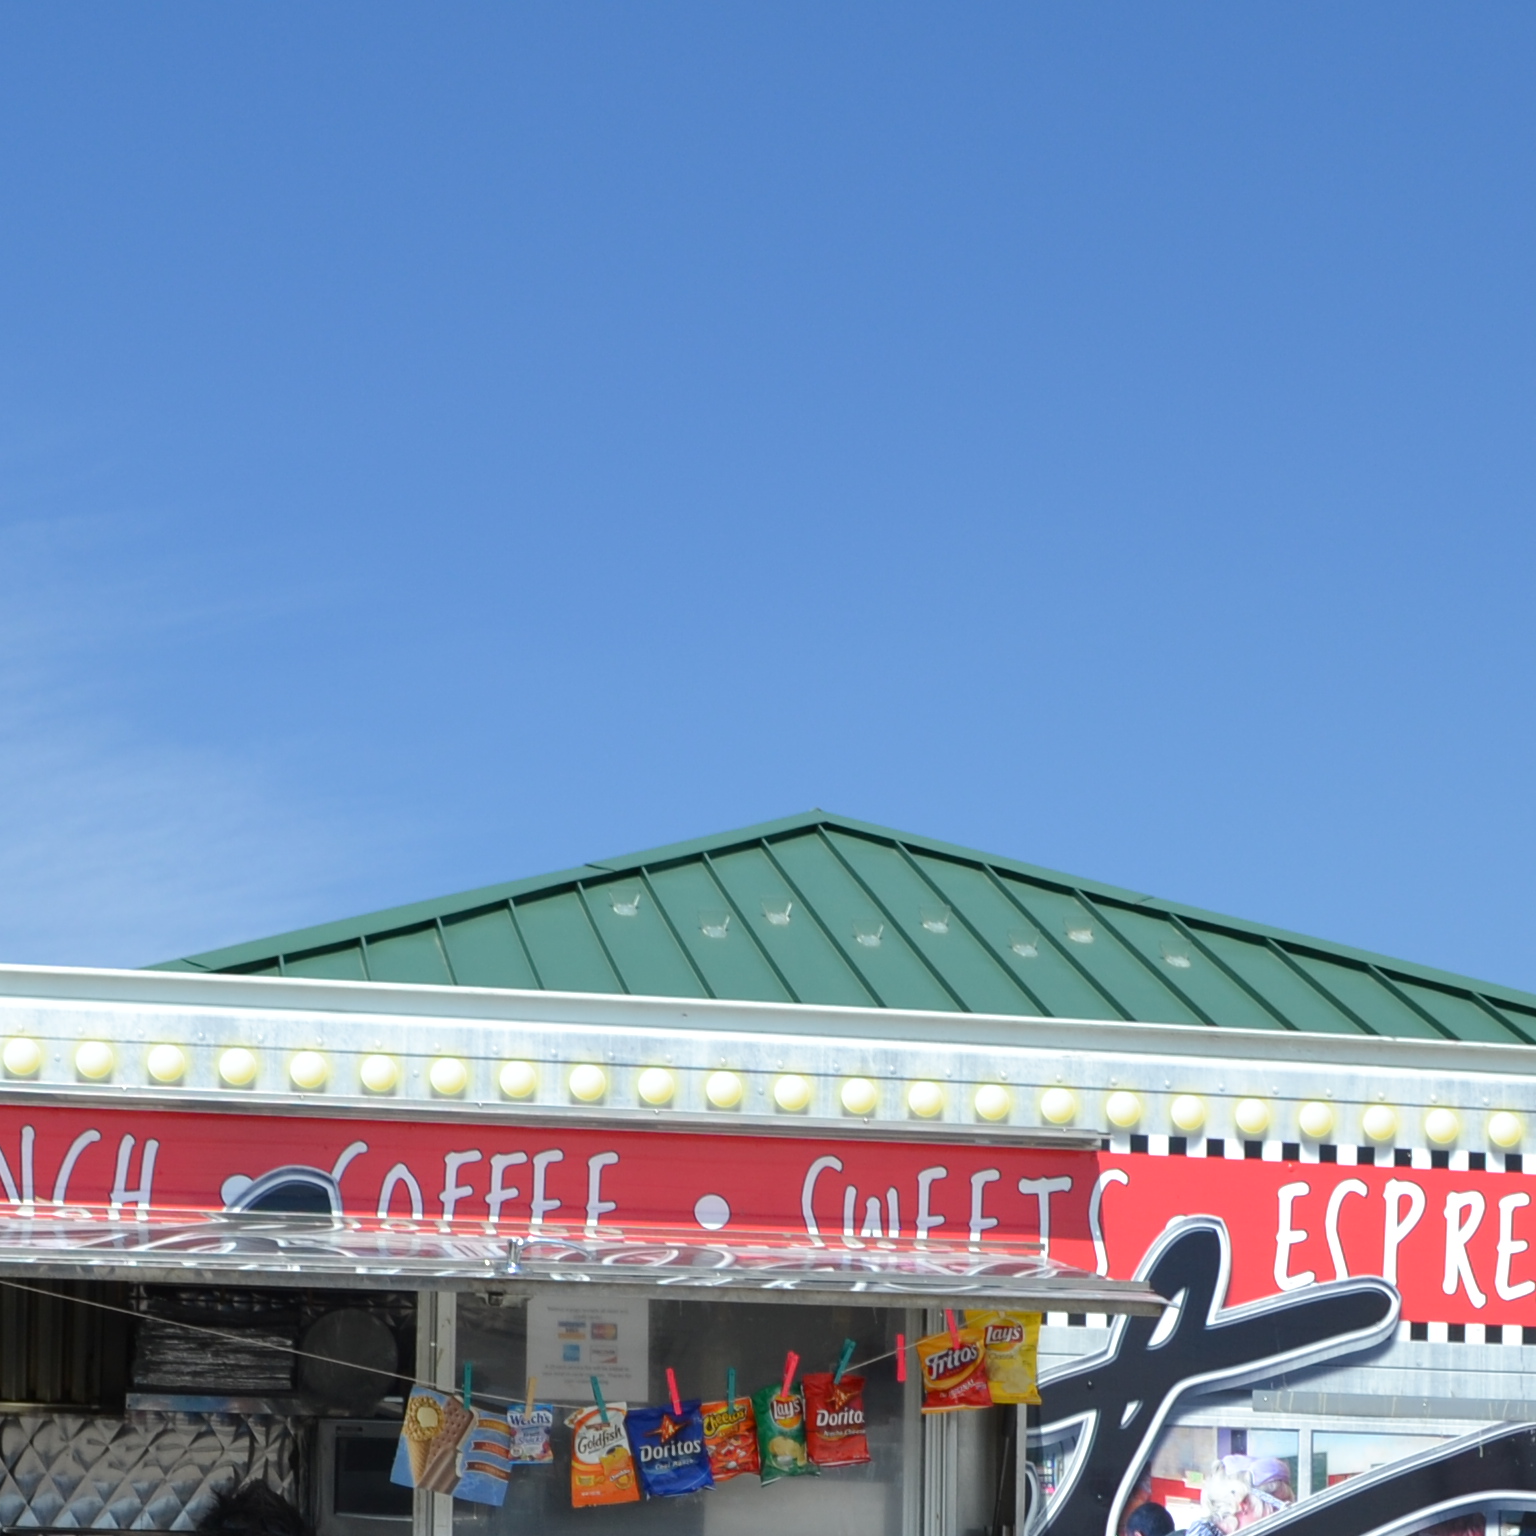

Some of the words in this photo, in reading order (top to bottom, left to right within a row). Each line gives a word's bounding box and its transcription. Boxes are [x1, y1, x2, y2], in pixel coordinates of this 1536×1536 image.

[800, 1155, 1130, 1278] SWEETS
[925, 1344, 980, 1381] Fritos
[816, 1407, 865, 1427] Dorito
[578, 1425, 623, 1454] Goldfish
[640, 1439, 701, 1462] Doritos
